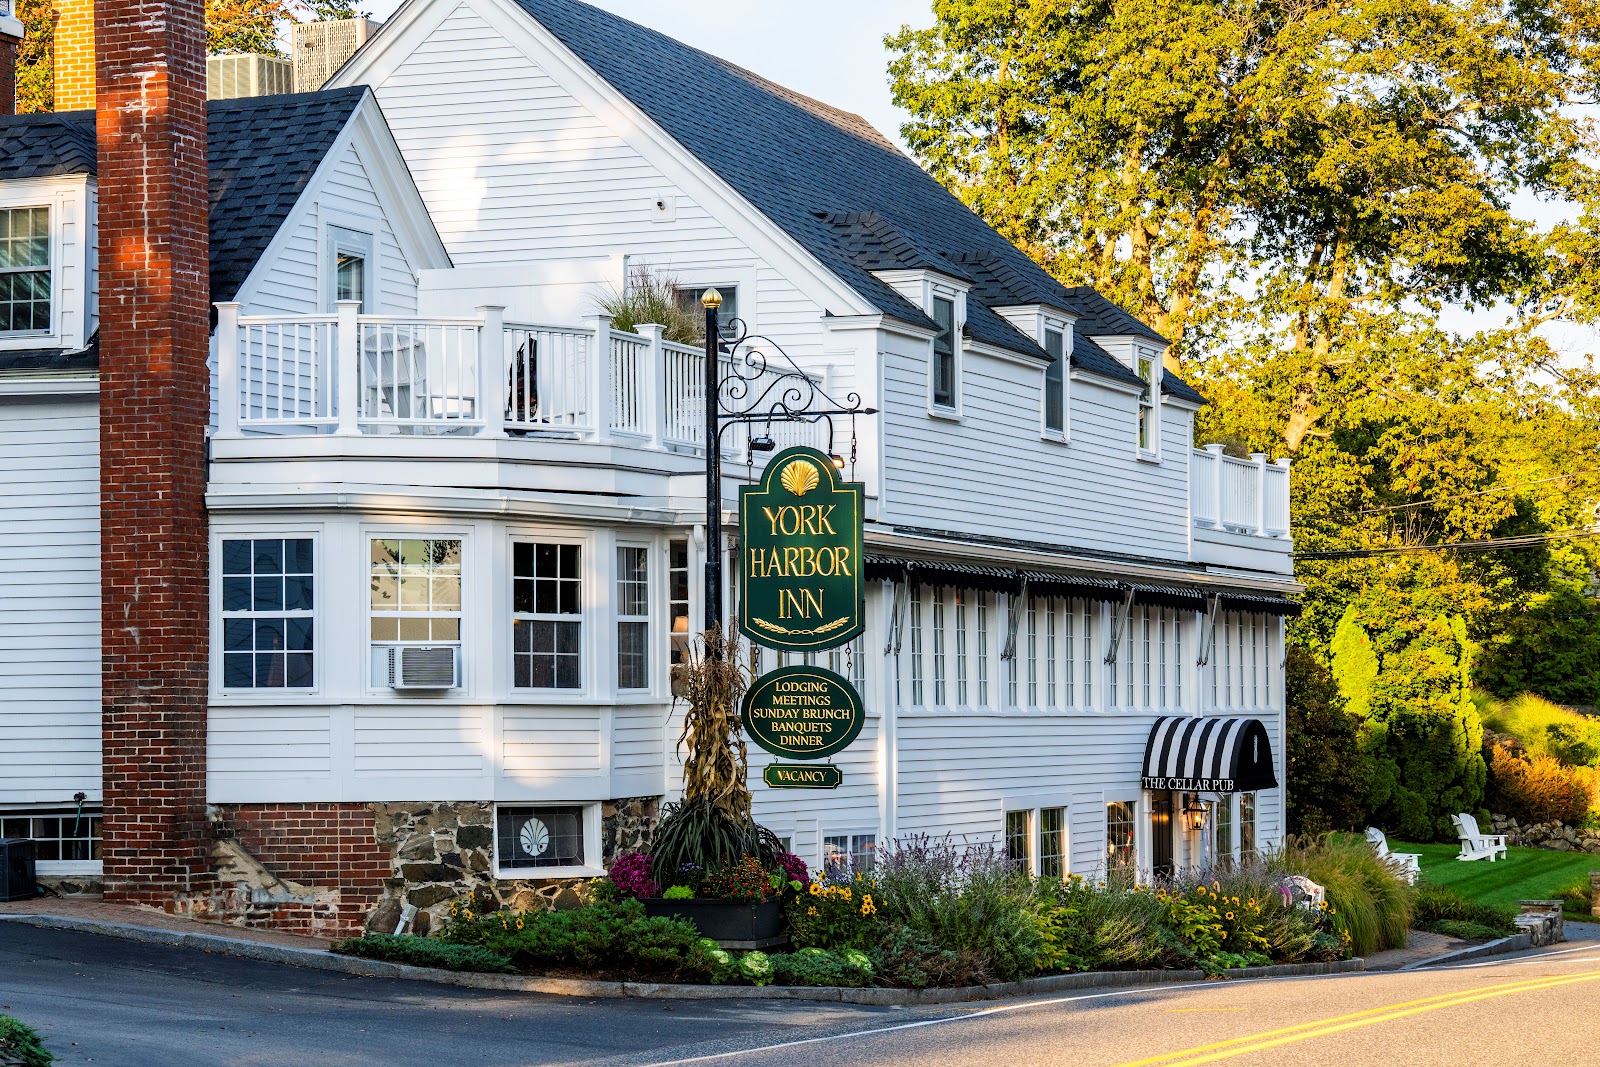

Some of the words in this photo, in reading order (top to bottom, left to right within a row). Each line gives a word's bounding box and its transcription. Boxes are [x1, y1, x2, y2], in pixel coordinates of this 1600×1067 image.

[762, 504, 837, 536] YORK
[750, 545, 852, 578] HARBOR
[778, 588, 825, 619] INN
[775, 681, 828, 693] LODGING
[772, 695, 831, 706] MEETINGS
[753, 708, 800, 719] SUNDAY
[802, 708, 851, 720] BRUNCH
[771, 721, 832, 734] BANQUETS
[780, 735, 825, 746] DINNER
[777, 770, 827, 782] VACANCY
[1142, 777, 1166, 790] THE
[1167, 777, 1210, 791] CELLAR
[1212, 779, 1235, 791] PUB
